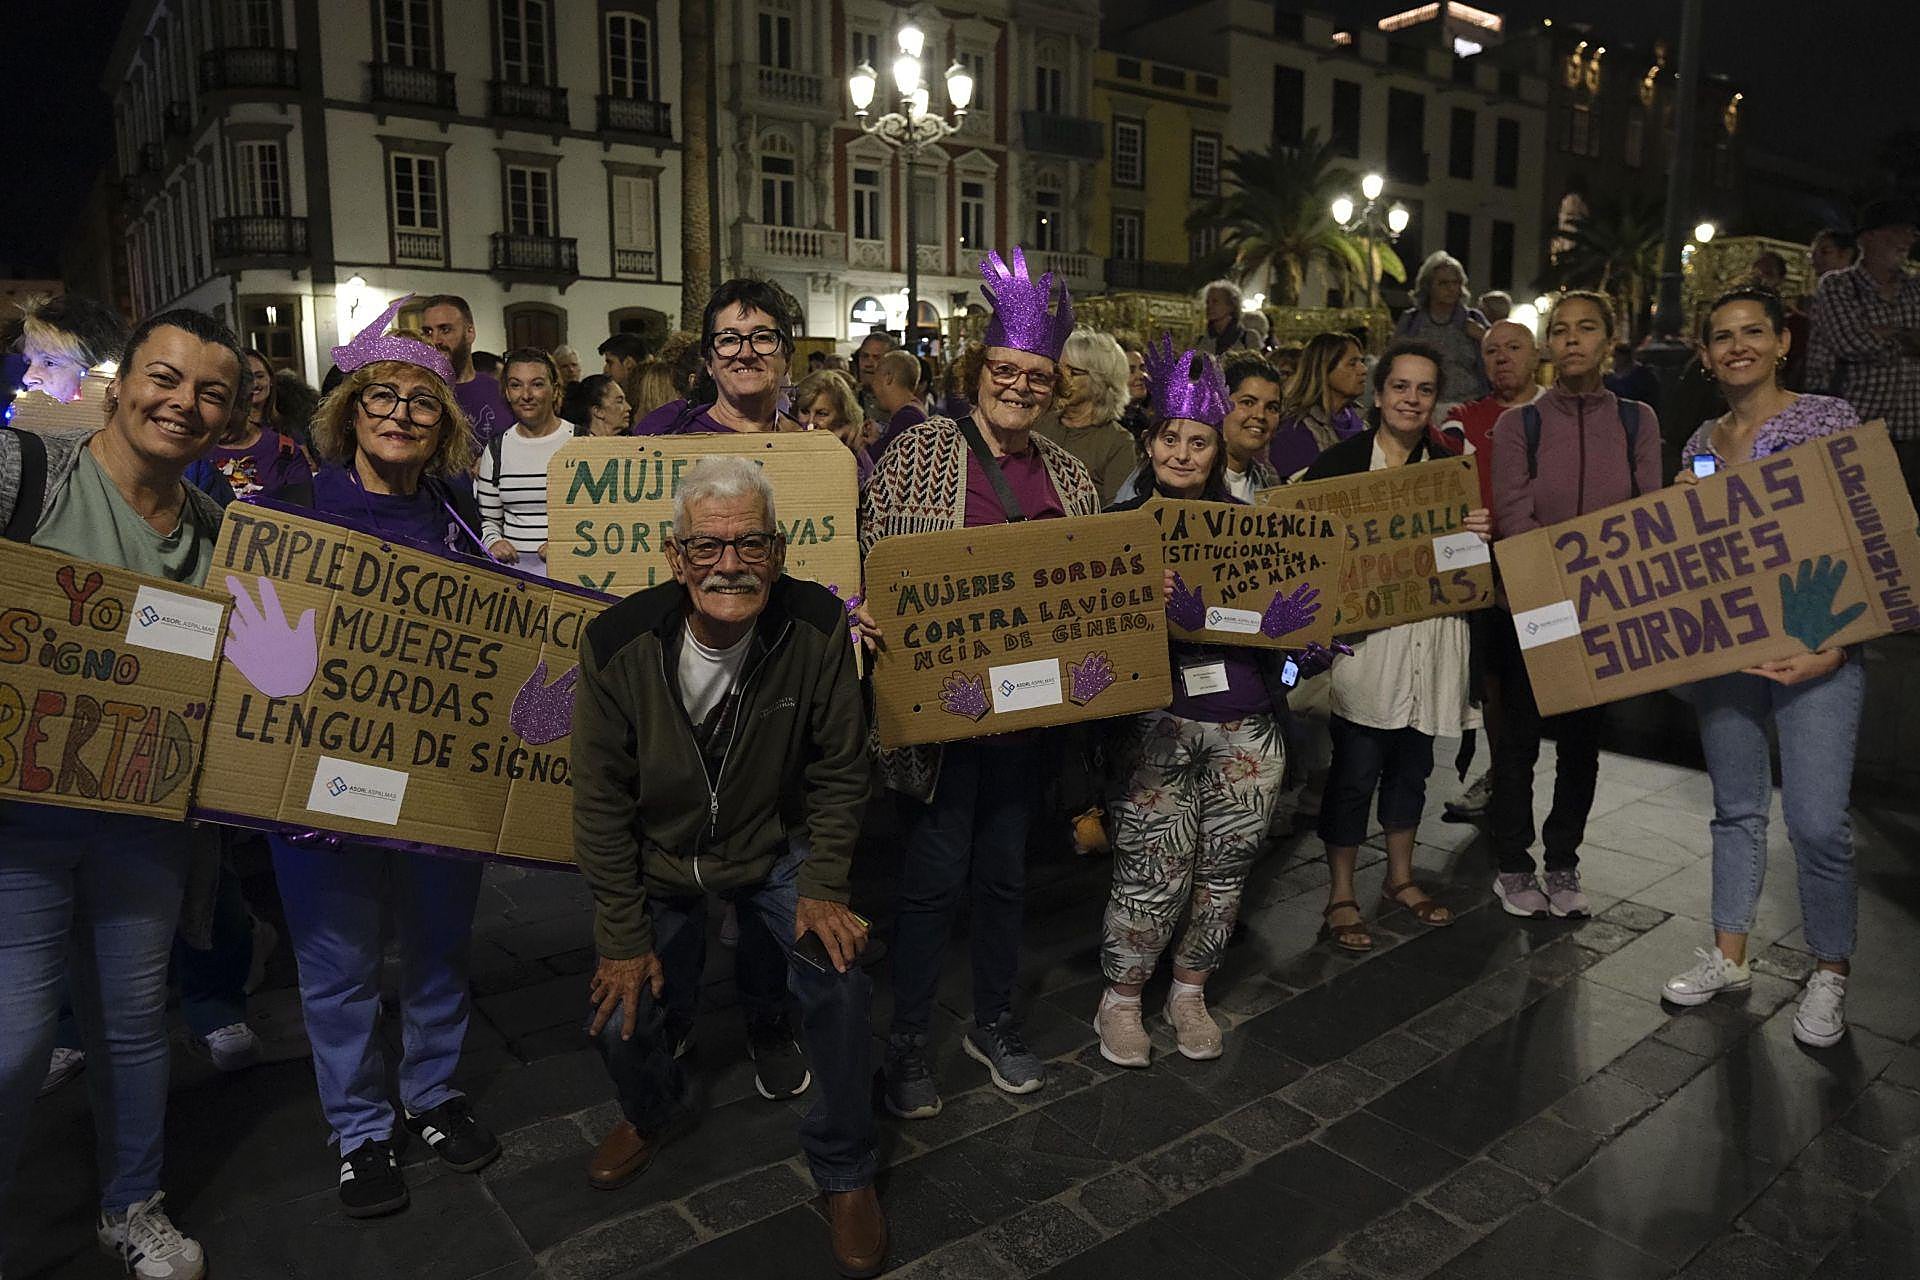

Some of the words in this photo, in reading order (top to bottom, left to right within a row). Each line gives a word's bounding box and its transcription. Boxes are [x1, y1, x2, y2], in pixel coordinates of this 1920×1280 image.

[1202, 507, 1335, 538] VIOLENCIA
[1555, 500, 1678, 574] 25N
[1684, 457, 1804, 536] LAS
[227, 513, 355, 591] TRIPLE
[352, 550, 587, 651] DISCRIMINACI
[1033, 553, 1145, 588] SORDAS
[1220, 575, 1260, 604] NOS
[1578, 520, 1791, 624] MUJERES
[328, 605, 503, 680] MUJERES
[903, 606, 1028, 649] CONTRA
[914, 637, 991, 672] NCIA
[1004, 631, 1033, 652] DE
[1580, 586, 1770, 680] SORDAS
[321, 658, 494, 727] SORDAS
[235, 694, 395, 762] LENGUA
[412, 728, 457, 769] DE
